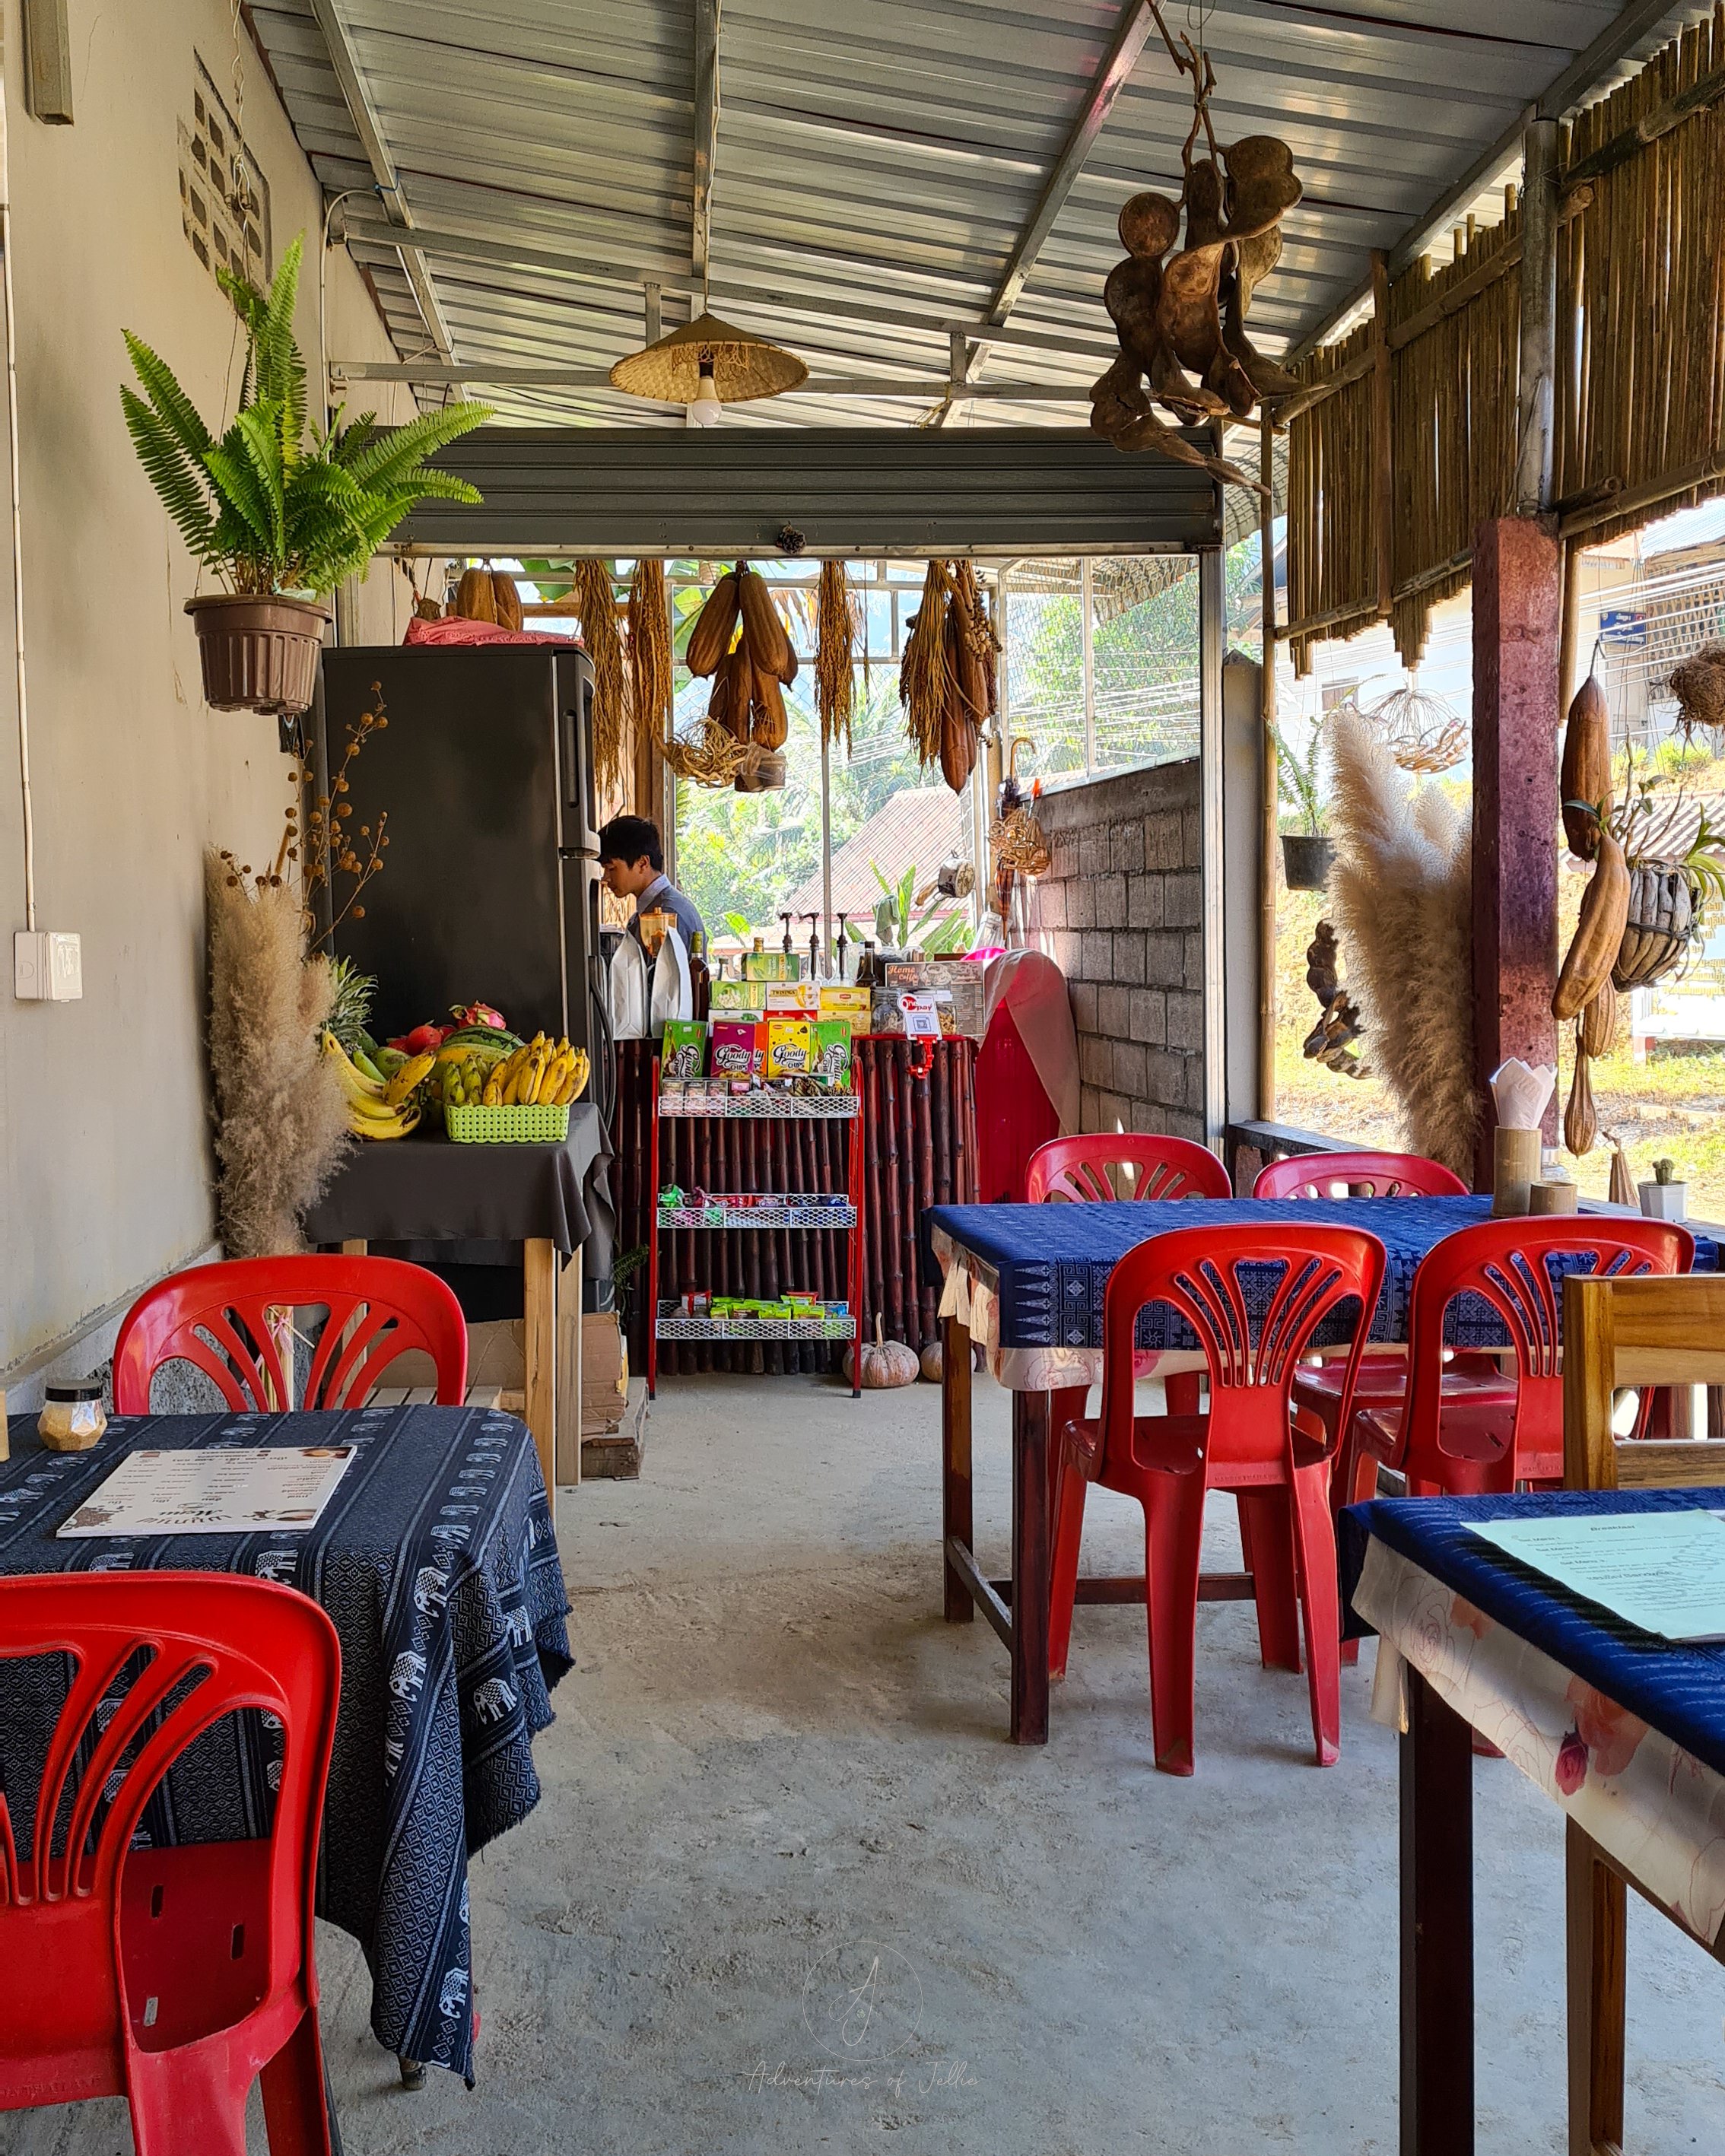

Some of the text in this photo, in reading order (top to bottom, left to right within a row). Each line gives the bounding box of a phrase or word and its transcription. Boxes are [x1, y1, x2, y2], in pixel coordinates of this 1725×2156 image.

[888, 965, 916, 974] Home
[715, 1044, 751, 1068] Goody
[773, 1043, 808, 1066] Goody
